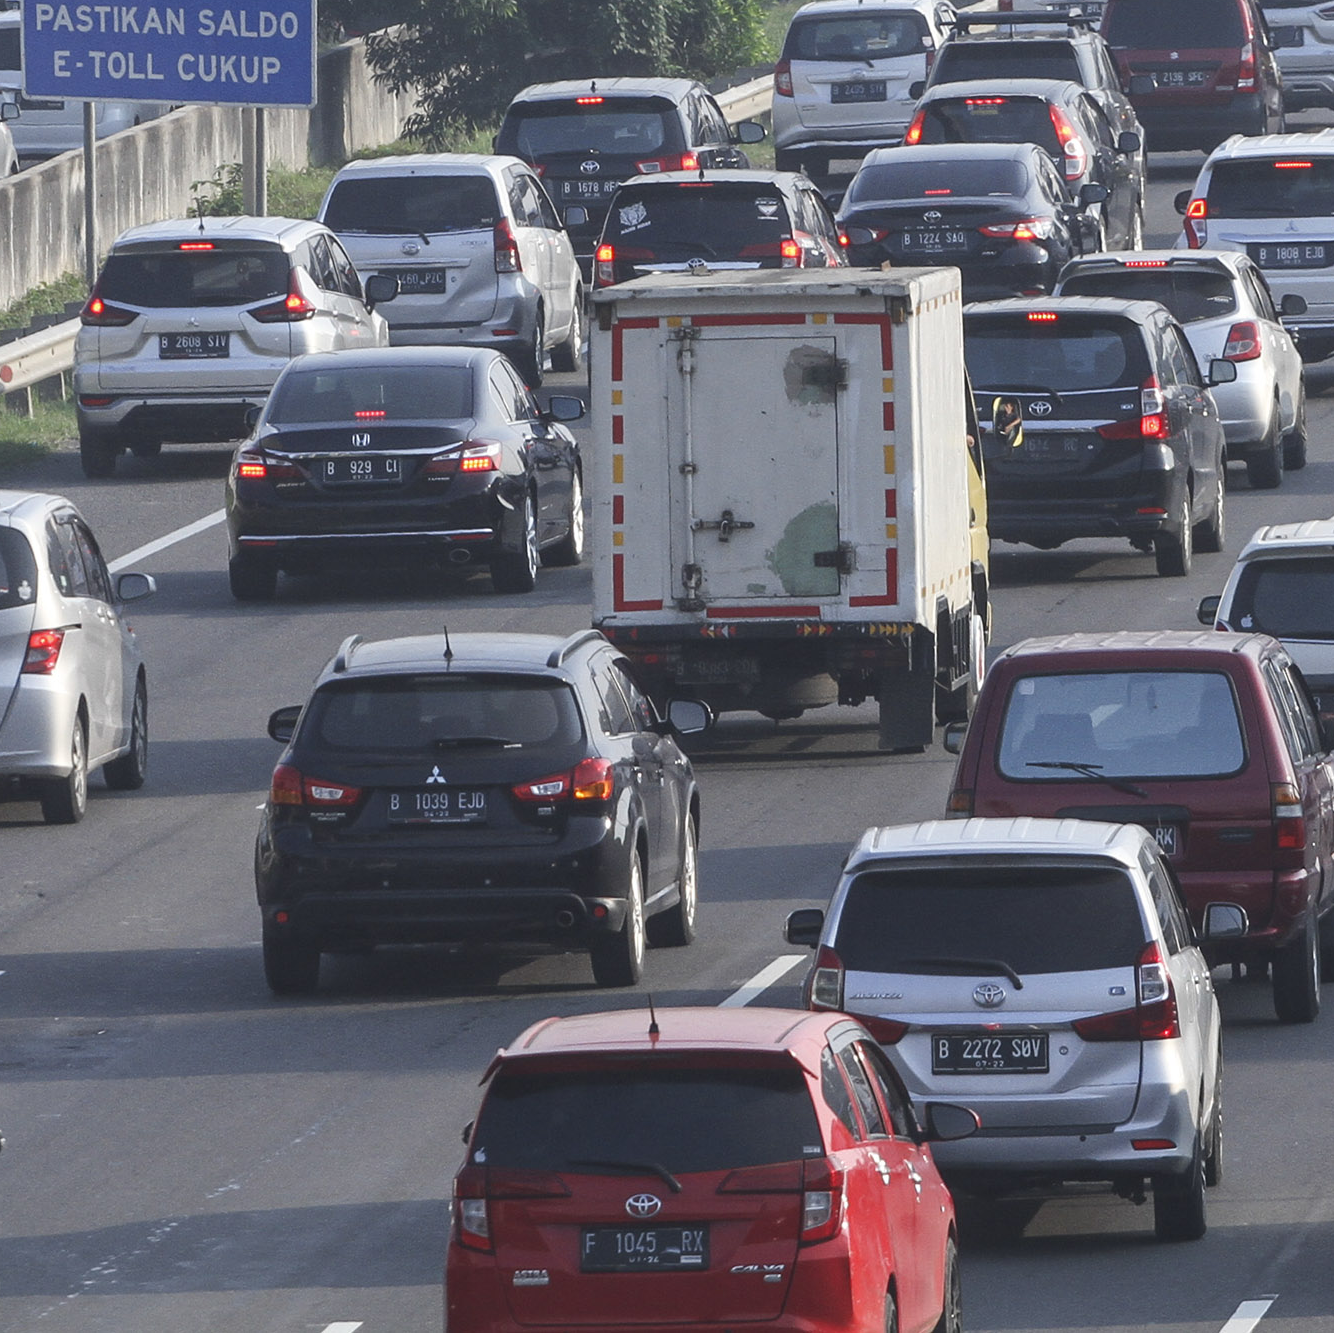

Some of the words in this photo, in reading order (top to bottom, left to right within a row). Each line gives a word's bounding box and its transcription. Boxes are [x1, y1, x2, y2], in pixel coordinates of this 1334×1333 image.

[36, 3, 186, 35] PASTIKAN
[198, 9, 299, 39] SALDO
[53, 50, 164, 80] E-TOLL
[177, 53, 281, 84] CUKUP
[564, 183, 570, 193] B
[578, 182, 599, 192] 1678
[904, 234, 911, 245] B
[918, 233, 940, 244] 1224
[1260, 248, 1267, 259] B
[1276, 247, 1299, 258] 1808
[162, 336, 168, 348] B
[175, 336, 201, 348] 2608
[207, 335, 227, 347] SIV
[327, 462, 334, 474] B
[350, 461, 372, 473] 929
[390, 794, 400, 810] B
[415, 793, 448, 810] 1039
[939, 1040, 949, 1058] B
[962, 1039, 1002, 1058] 2272
[585, 1232, 595, 1253] F
[616, 1231, 657, 1253] 1045
[681, 1230, 703, 1252] RX
[514, 1269, 549, 1278] ASTRA
[730, 1264, 785, 1274] CALYA
